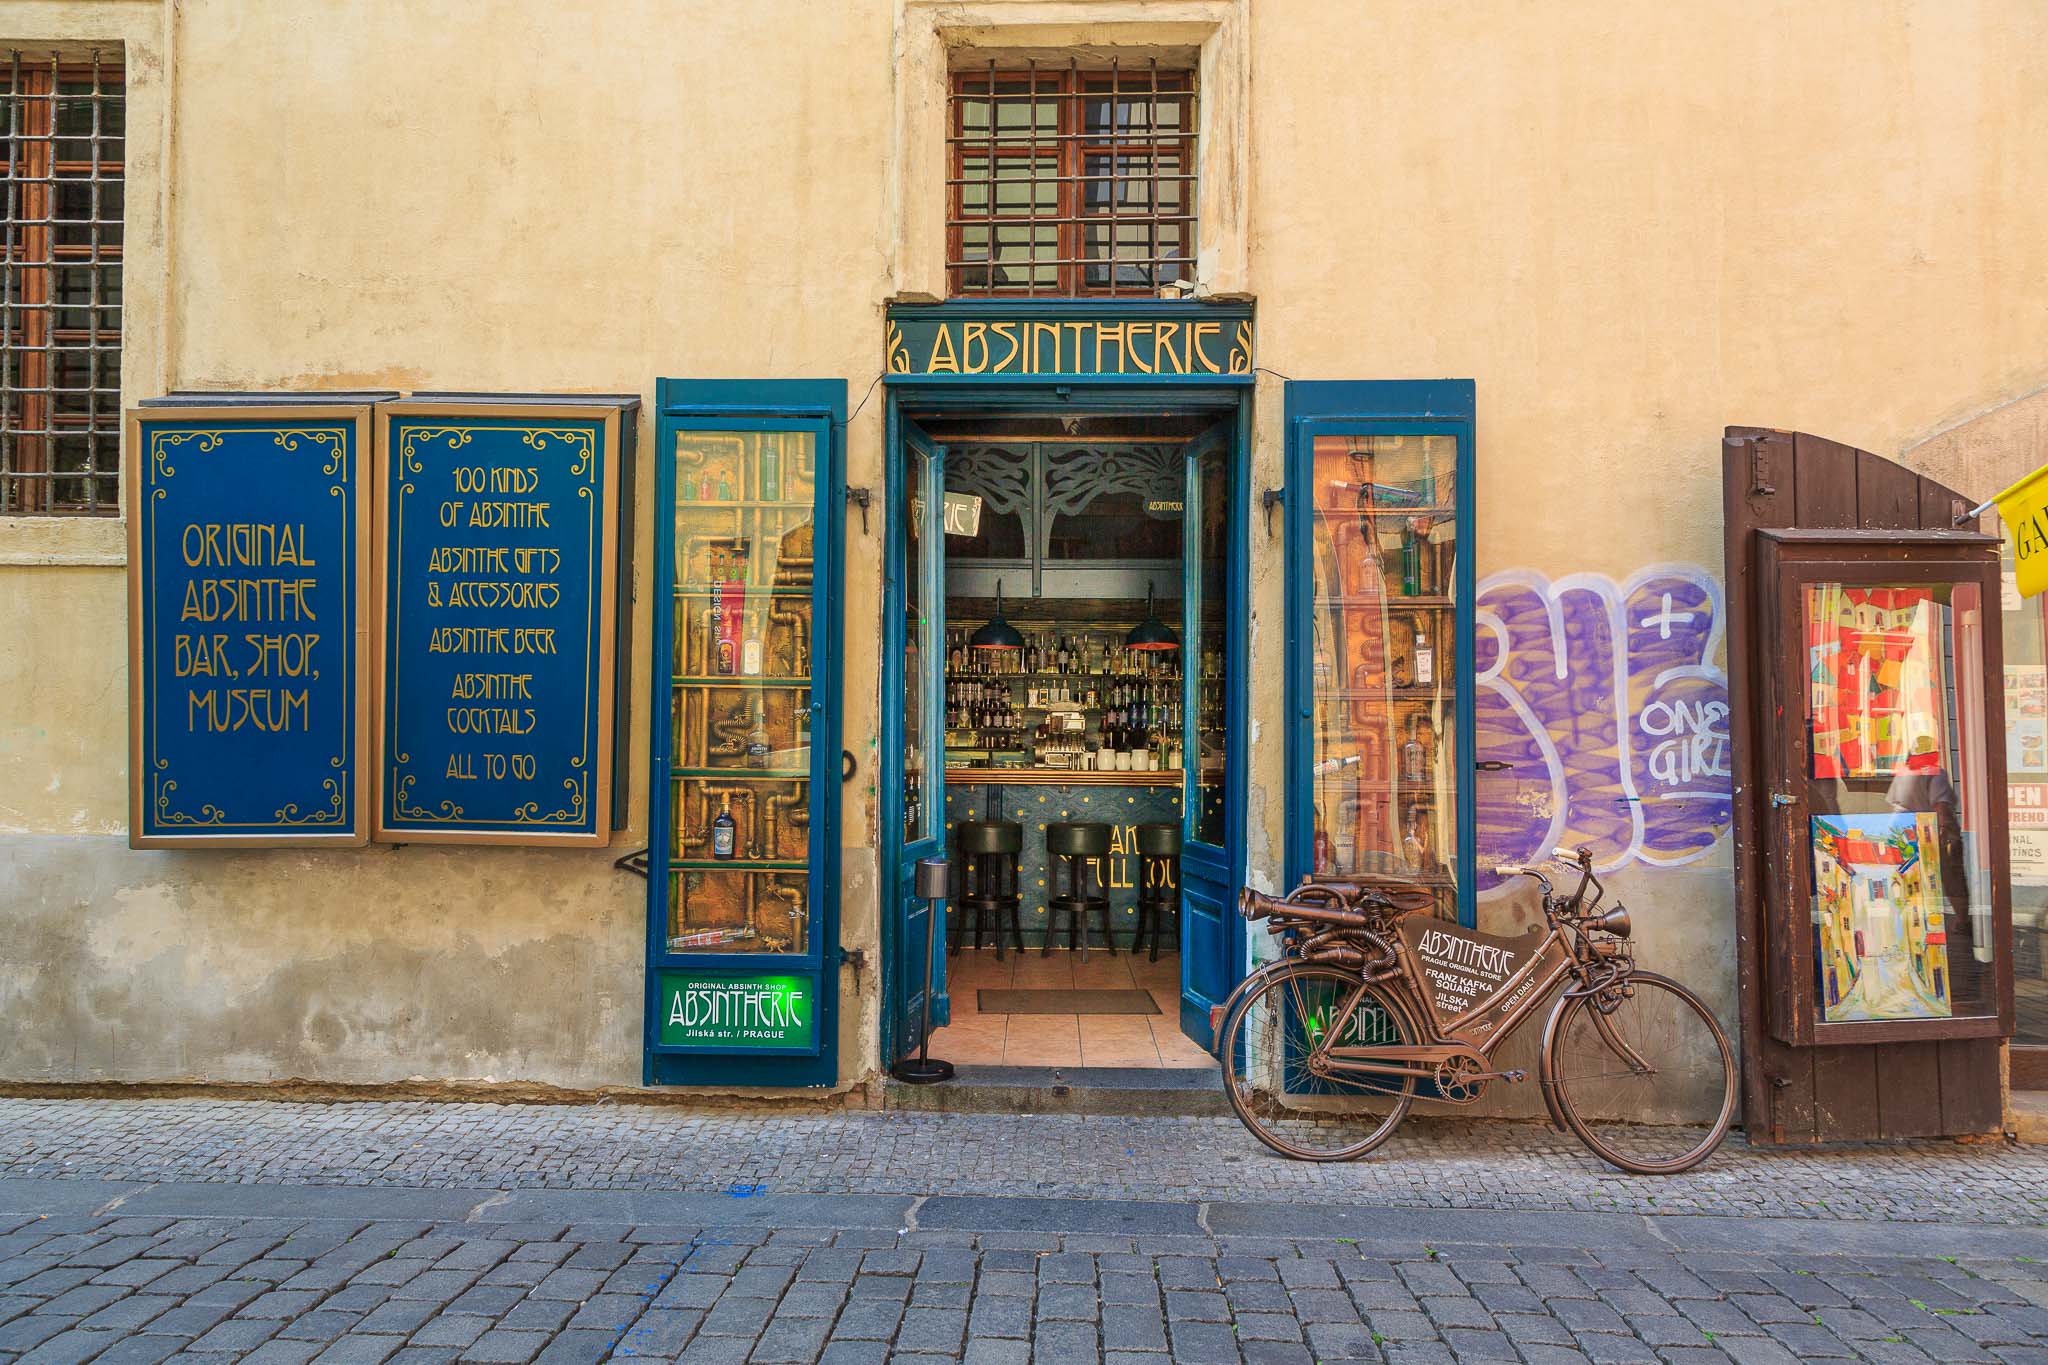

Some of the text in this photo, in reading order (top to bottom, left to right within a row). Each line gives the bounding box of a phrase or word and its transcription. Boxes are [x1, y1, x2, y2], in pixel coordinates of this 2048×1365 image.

[927, 321, 1221, 374] ABSINTHERIE
[452, 467, 539, 493] 100 KINDS
[439, 501, 551, 528] OF ABSINTHE
[182, 524, 316, 567] ORIGINAL
[2017, 504, 2048, 561] GA
[428, 547, 561, 574] ABSINTHE GIFTS
[181, 578, 317, 622] ABSINTHE
[427, 582, 560, 609] & ACCESSORIES
[428, 627, 557, 655] ABSINTHE BEER
[175, 633, 320, 680] BAR, SHOP,
[451, 673, 533, 699] ABSINTHE
[188, 689, 309, 732] MUSEUM
[447, 708, 536, 735] COCKTAILS
[1639, 700, 1730, 740] ONE
[446, 753, 536, 781] ALL TO GO
[1648, 734, 1732, 785] GIRL
[1418, 929, 1515, 976] ABSINTHERIE
[1421, 955, 1502, 981] PRAGUE ORIGINAL STORE
[1425, 968, 1493, 992] FRANZ KAFKA
[688, 982, 726, 990] ORIGINAL
[728, 983, 763, 991] ABSINTH
[1434, 992, 1469, 1008] JILSKA
[1435, 980, 1477, 997] SQUARE
[1501, 976, 1536, 1012] OPEN DAILY
[668, 991, 803, 1027] ABSINTHERIE
[1436, 1001, 1462, 1013] street
[686, 1029, 715, 1038] Jilská
[717, 1030, 734, 1038] str.
[743, 1030, 785, 1039] PRAGUE
